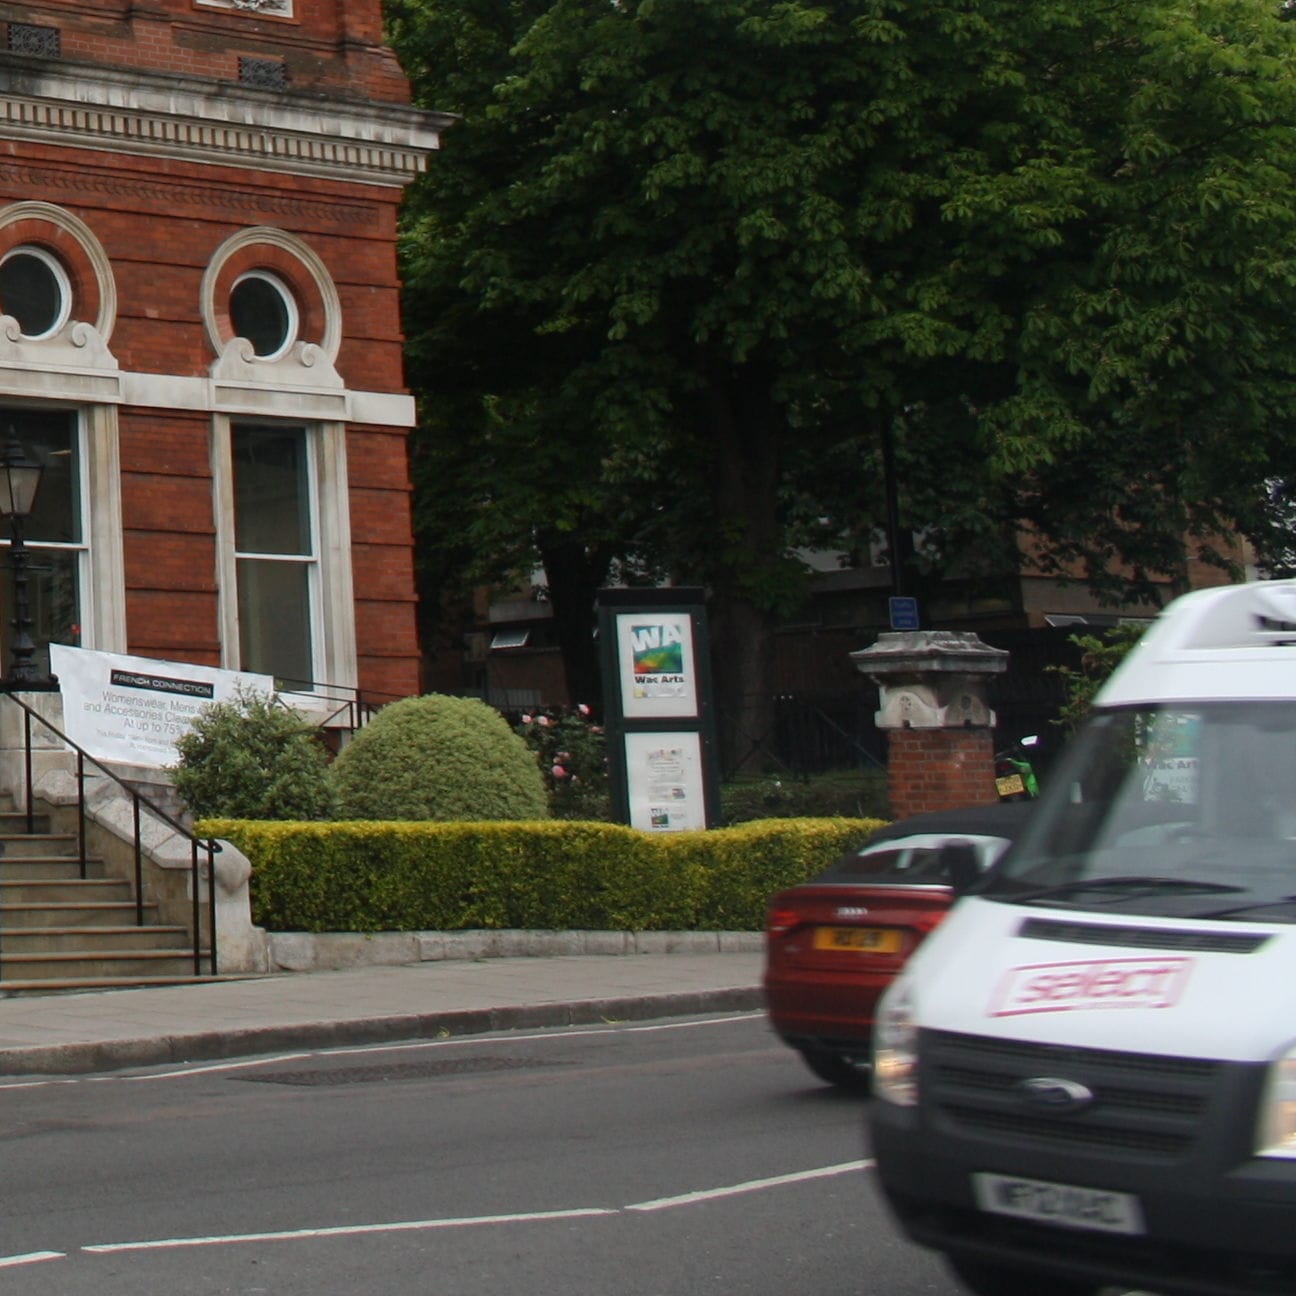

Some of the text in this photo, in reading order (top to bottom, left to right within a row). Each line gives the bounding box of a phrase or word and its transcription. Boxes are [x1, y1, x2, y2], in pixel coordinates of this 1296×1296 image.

[631, 625, 682, 652] WA
[113, 673, 211, 695] FRENCH CONNECTION
[634, 676, 684, 684] Wac Arts
[84, 702, 101, 713] and
[104, 705, 162, 721] Accessories
[136, 721, 148, 732] up
[151, 722, 162, 733] to
[1017, 963, 1176, 1001] select
